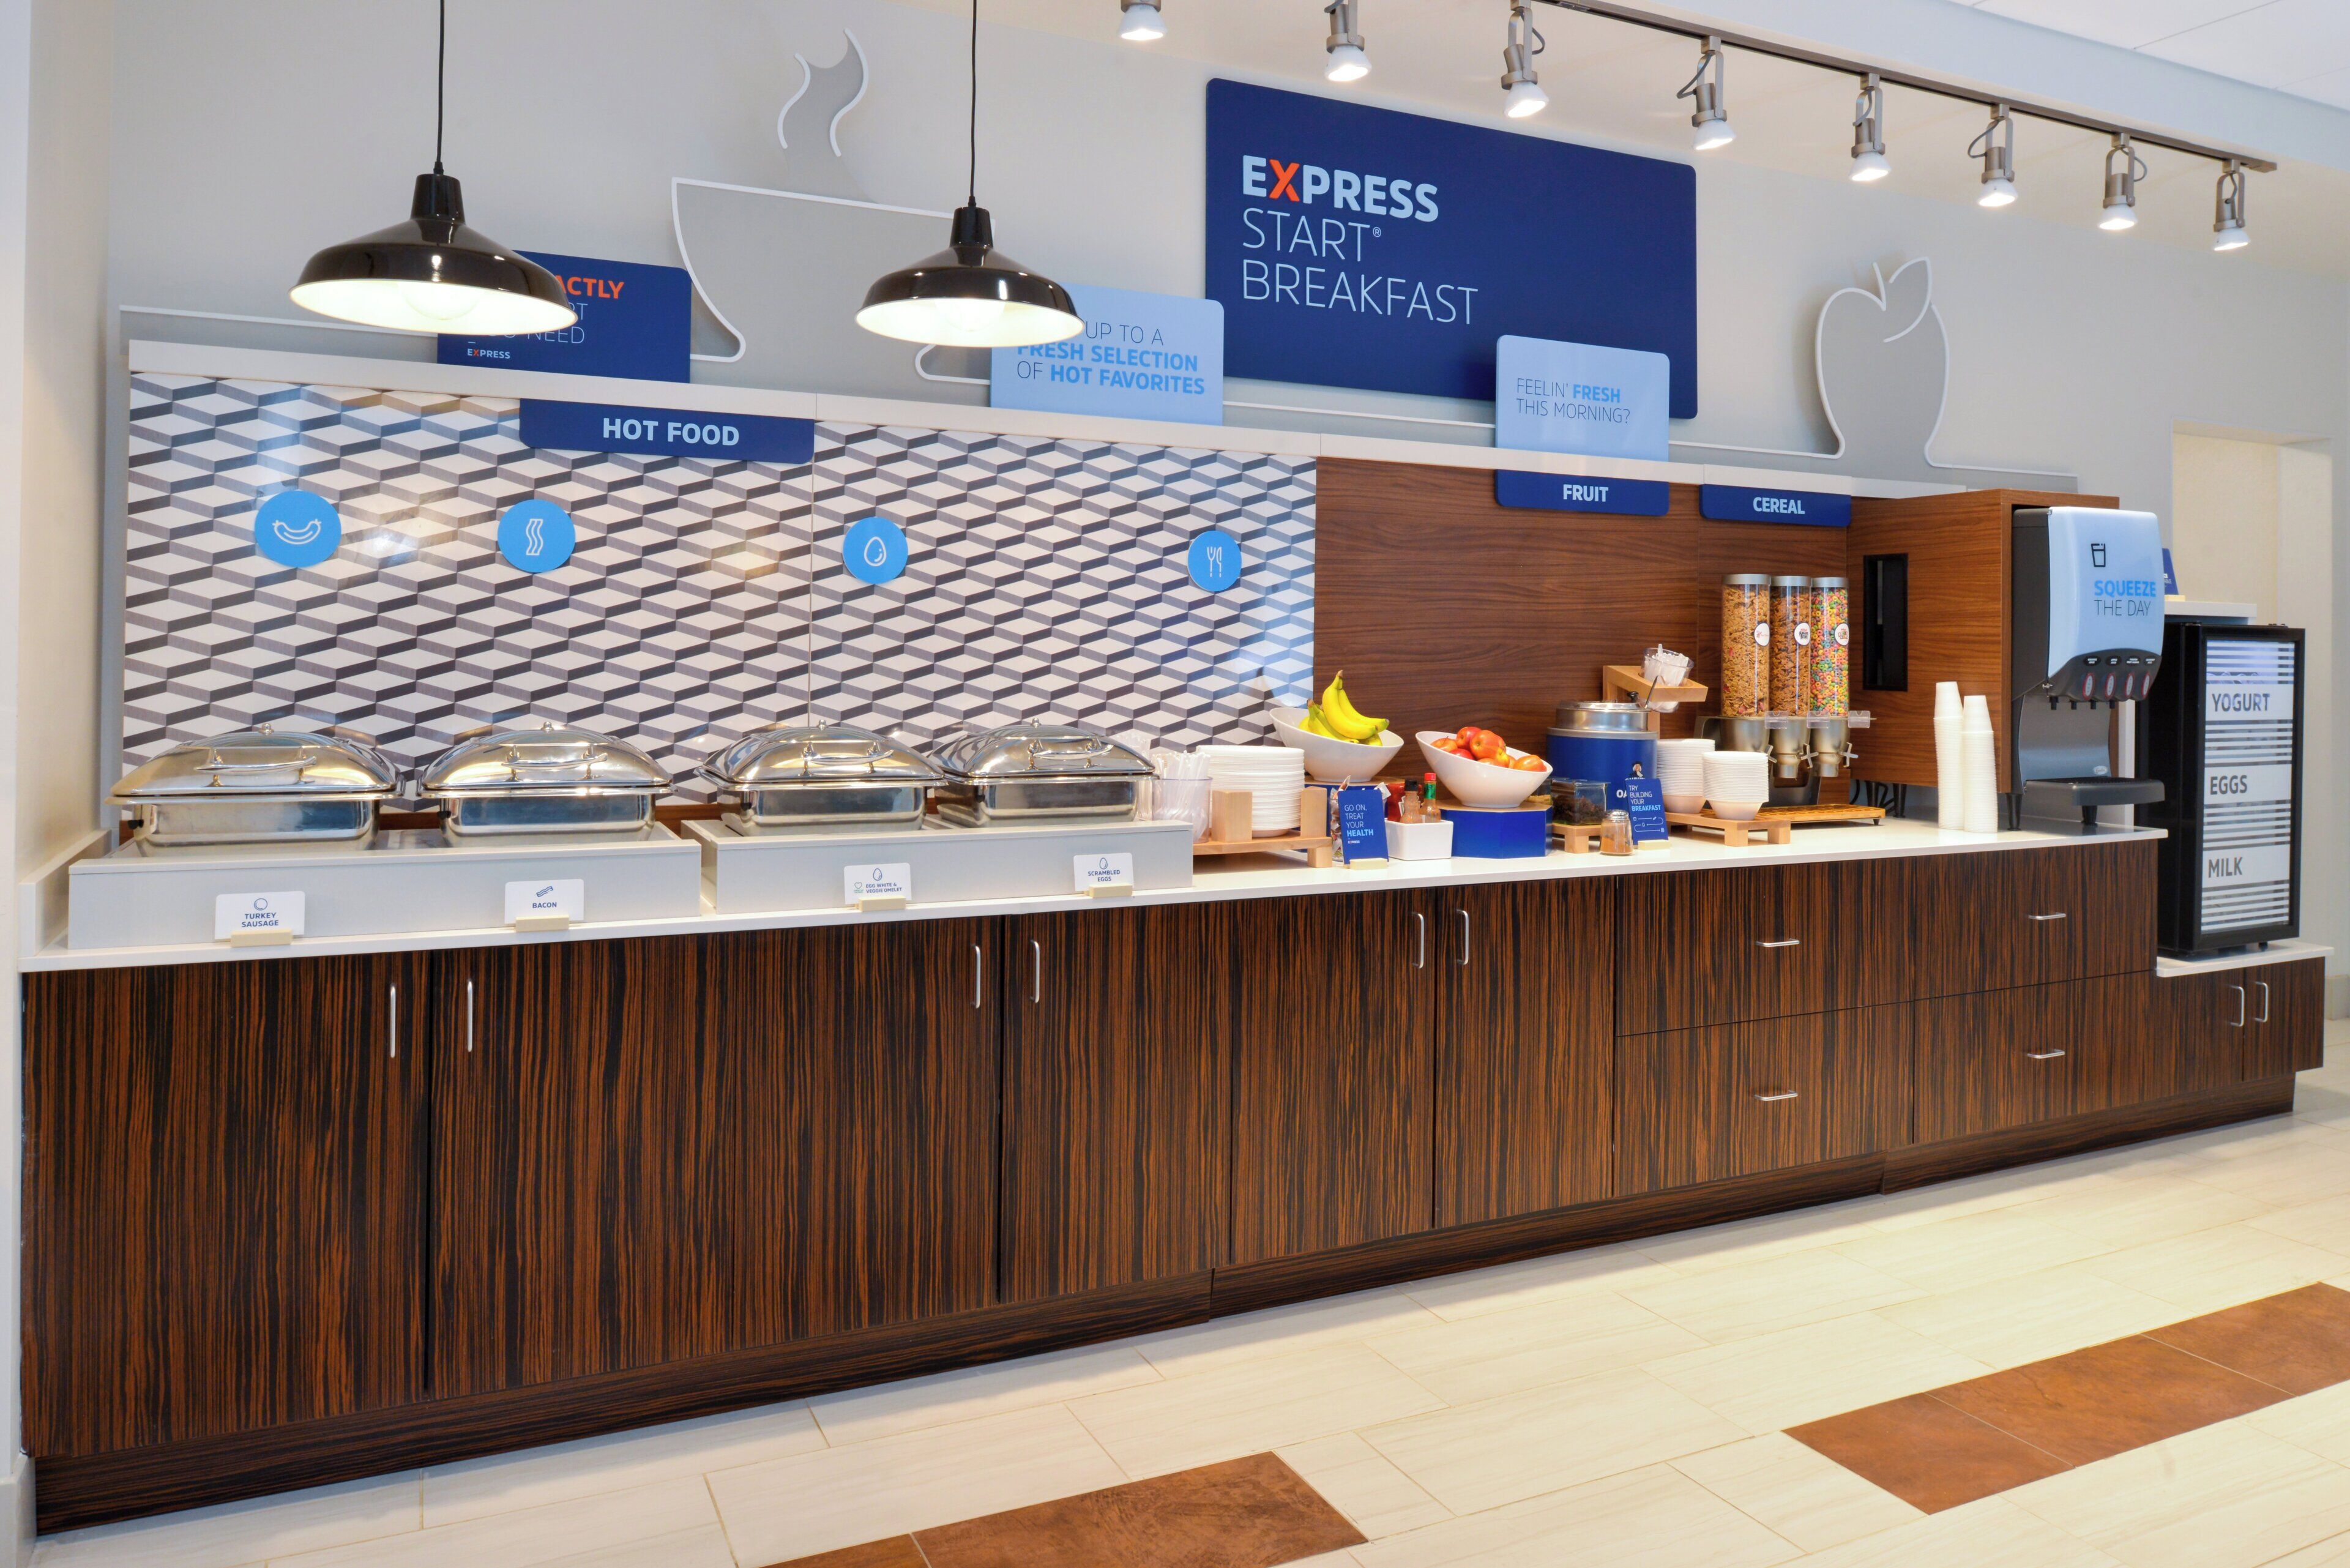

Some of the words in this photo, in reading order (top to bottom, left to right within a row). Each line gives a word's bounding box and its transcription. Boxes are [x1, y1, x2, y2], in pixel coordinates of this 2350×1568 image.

[1242, 155, 1439, 222] EXPRESS
[1243, 259, 1479, 325] BREAKFAST
[1086, 321, 1111, 340] UP
[1119, 324, 1144, 343] TO
[1151, 329, 1163, 346] A
[467, 348, 510, 359] EXPRESS
[1091, 345, 1198, 371] SELECTION
[1017, 360, 1043, 379] OF
[1051, 364, 1092, 384] HOT
[1100, 369, 1205, 395] FAVORITES
[1516, 378, 1568, 397] FEELIN'
[1573, 384, 1621, 403] FRESH
[1516, 398, 1548, 416] THIS
[1554, 402, 1630, 424] MORNING?
[603, 417, 658, 441] HOT
[668, 422, 739, 446] FOOD
[1563, 484, 1609, 502] FRUIT
[1753, 496, 1805, 515] CEREAL
[2094, 580, 2156, 597] SQUEEZE
[2094, 600, 2122, 616] THE
[2128, 600, 2151, 616] DAY
[2212, 693, 2270, 712] YOGURT
[2210, 775, 2248, 795] EGGS
[1346, 829, 1374, 837] HEALTH
[2208, 857, 2243, 878] MILK
